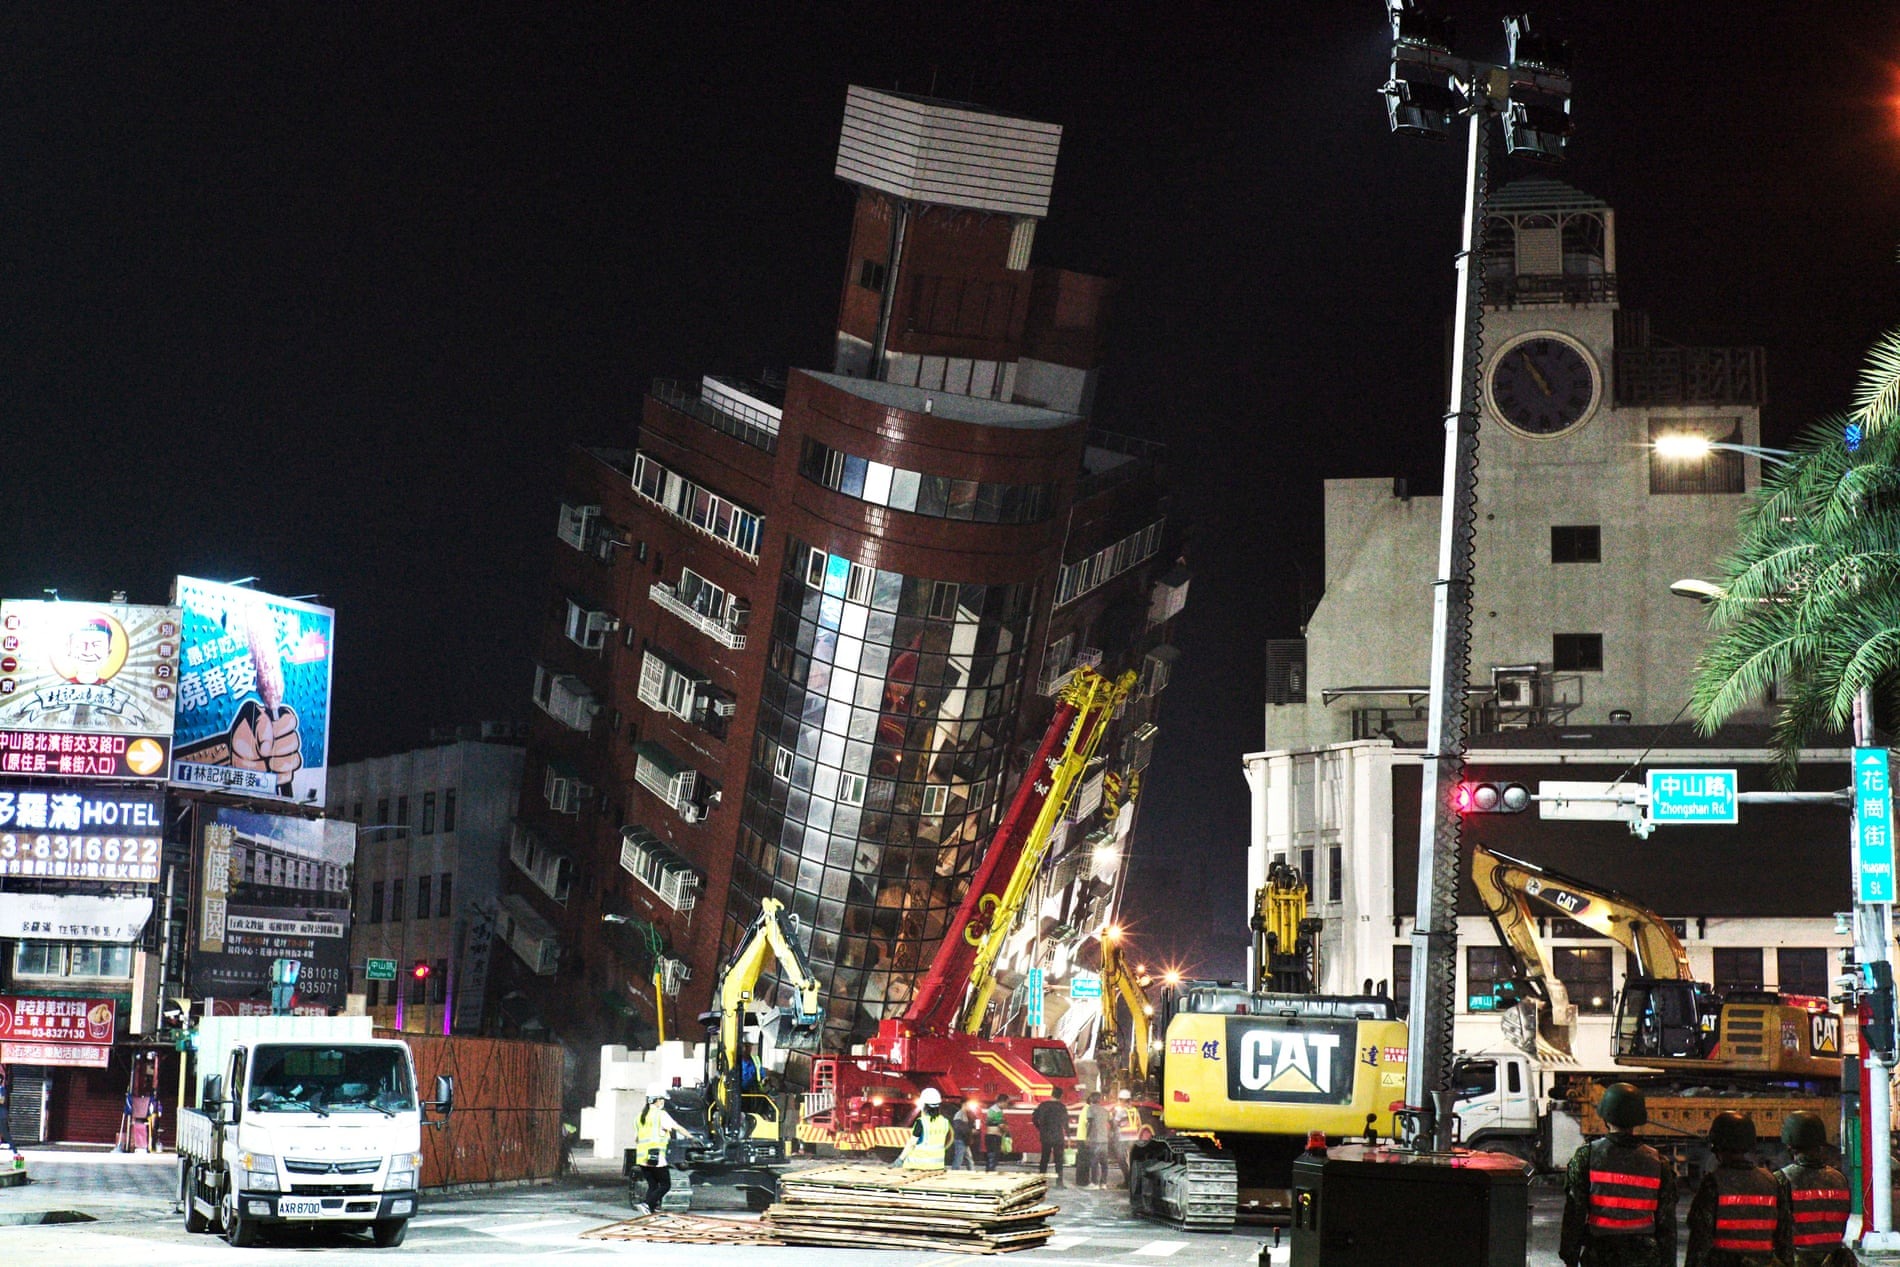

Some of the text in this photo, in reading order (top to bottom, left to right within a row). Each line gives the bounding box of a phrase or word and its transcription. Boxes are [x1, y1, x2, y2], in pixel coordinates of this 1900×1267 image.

[1661, 775, 1726, 797] 中山路
[83, 800, 160, 826] HOTEL
[1660, 801, 1726, 818] Zhongshan Rd.
[1862, 770, 1885, 847] 花崗街
[1556, 891, 1578, 912] CAT
[1702, 1015, 1717, 1031] AT
[1812, 1016, 1838, 1050] CAT
[1201, 1040, 1221, 1060] 健
[1240, 1030, 1340, 1094] CAT
